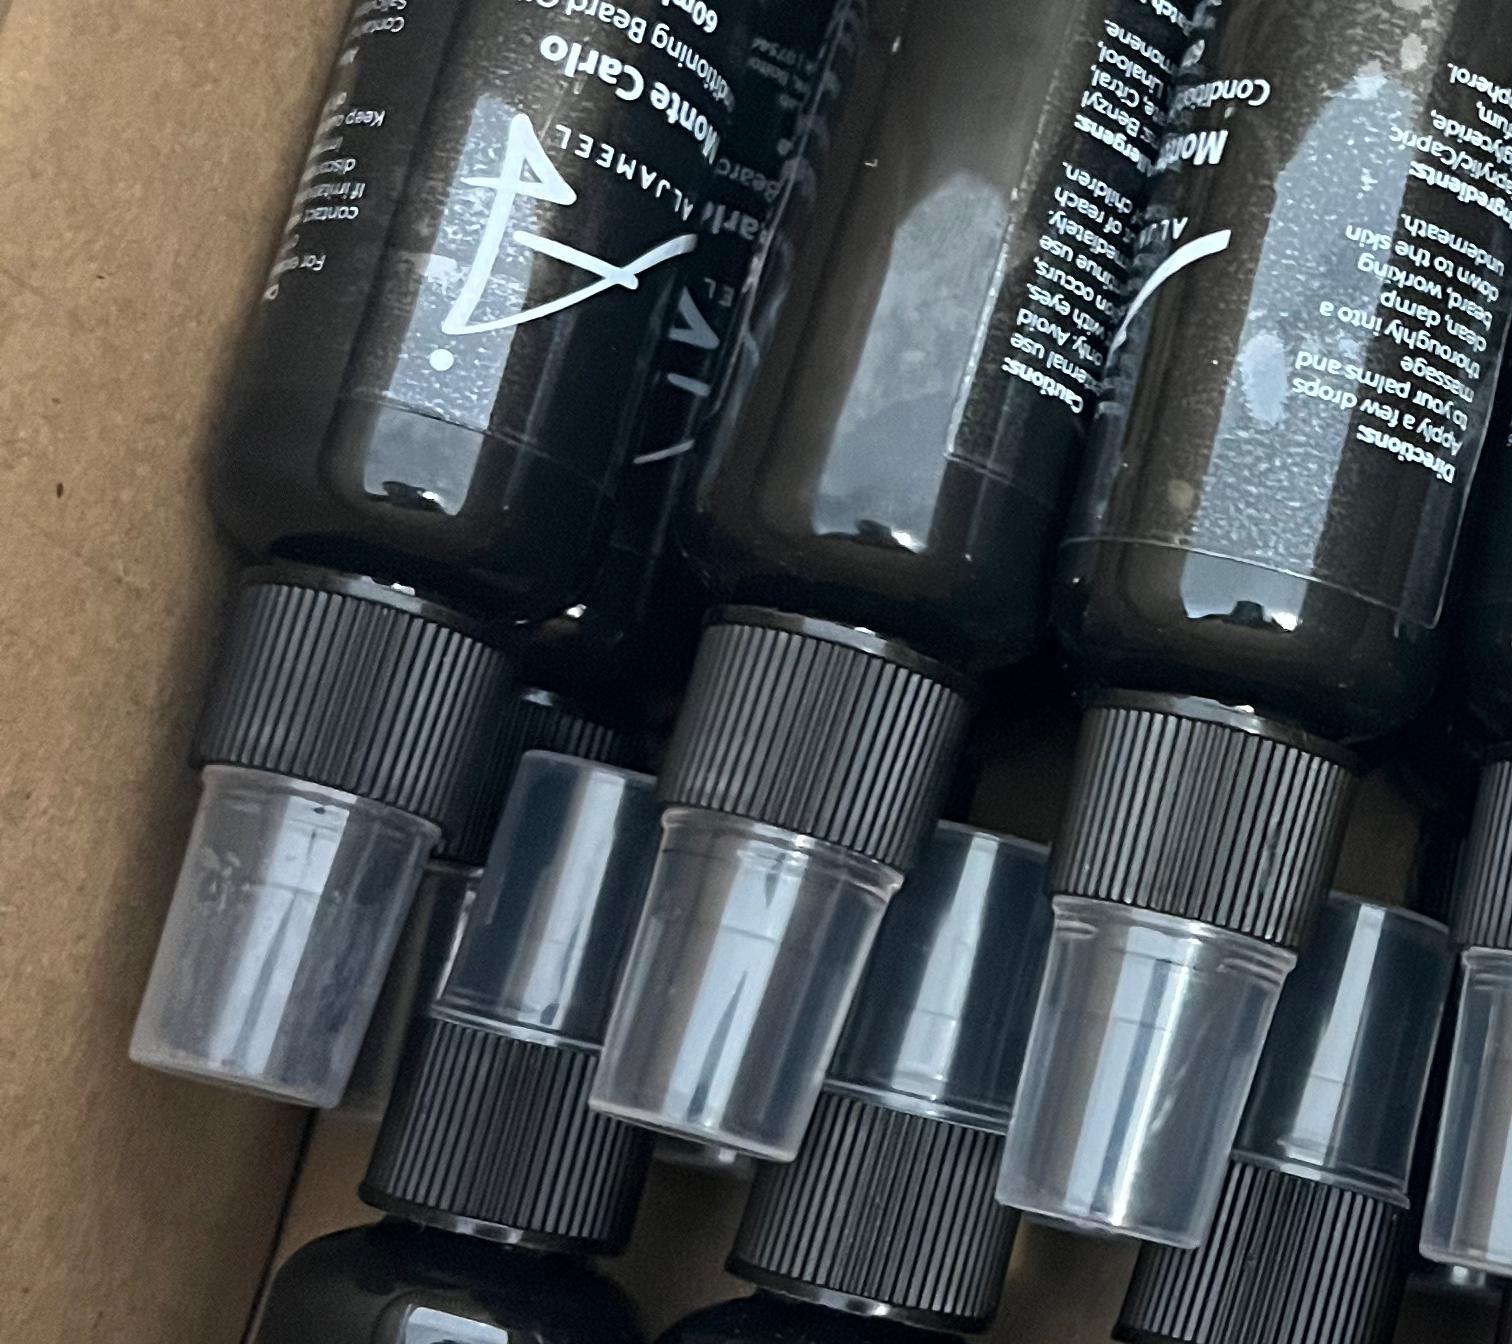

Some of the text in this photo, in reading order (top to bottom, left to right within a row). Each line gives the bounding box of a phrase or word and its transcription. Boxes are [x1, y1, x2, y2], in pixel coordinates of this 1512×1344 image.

[540, 35, 719, 164] Monte Carlo
[555, 123, 694, 221] ALJAMEEL
[1062, 161, 1133, 215] children.
[1054, 187, 1105, 223] reach
[1401, 212, 1505, 277] underneath.
[1016, 308, 1071, 347] Avoid
[1026, 283, 1070, 318] eyes.
[1001, 356, 1083, 414] Cautions:
[1400, 355, 1475, 404] massage
[1291, 376, 1463, 456] Apply a few drops
[1357, 424, 1456, 484] Directions:
